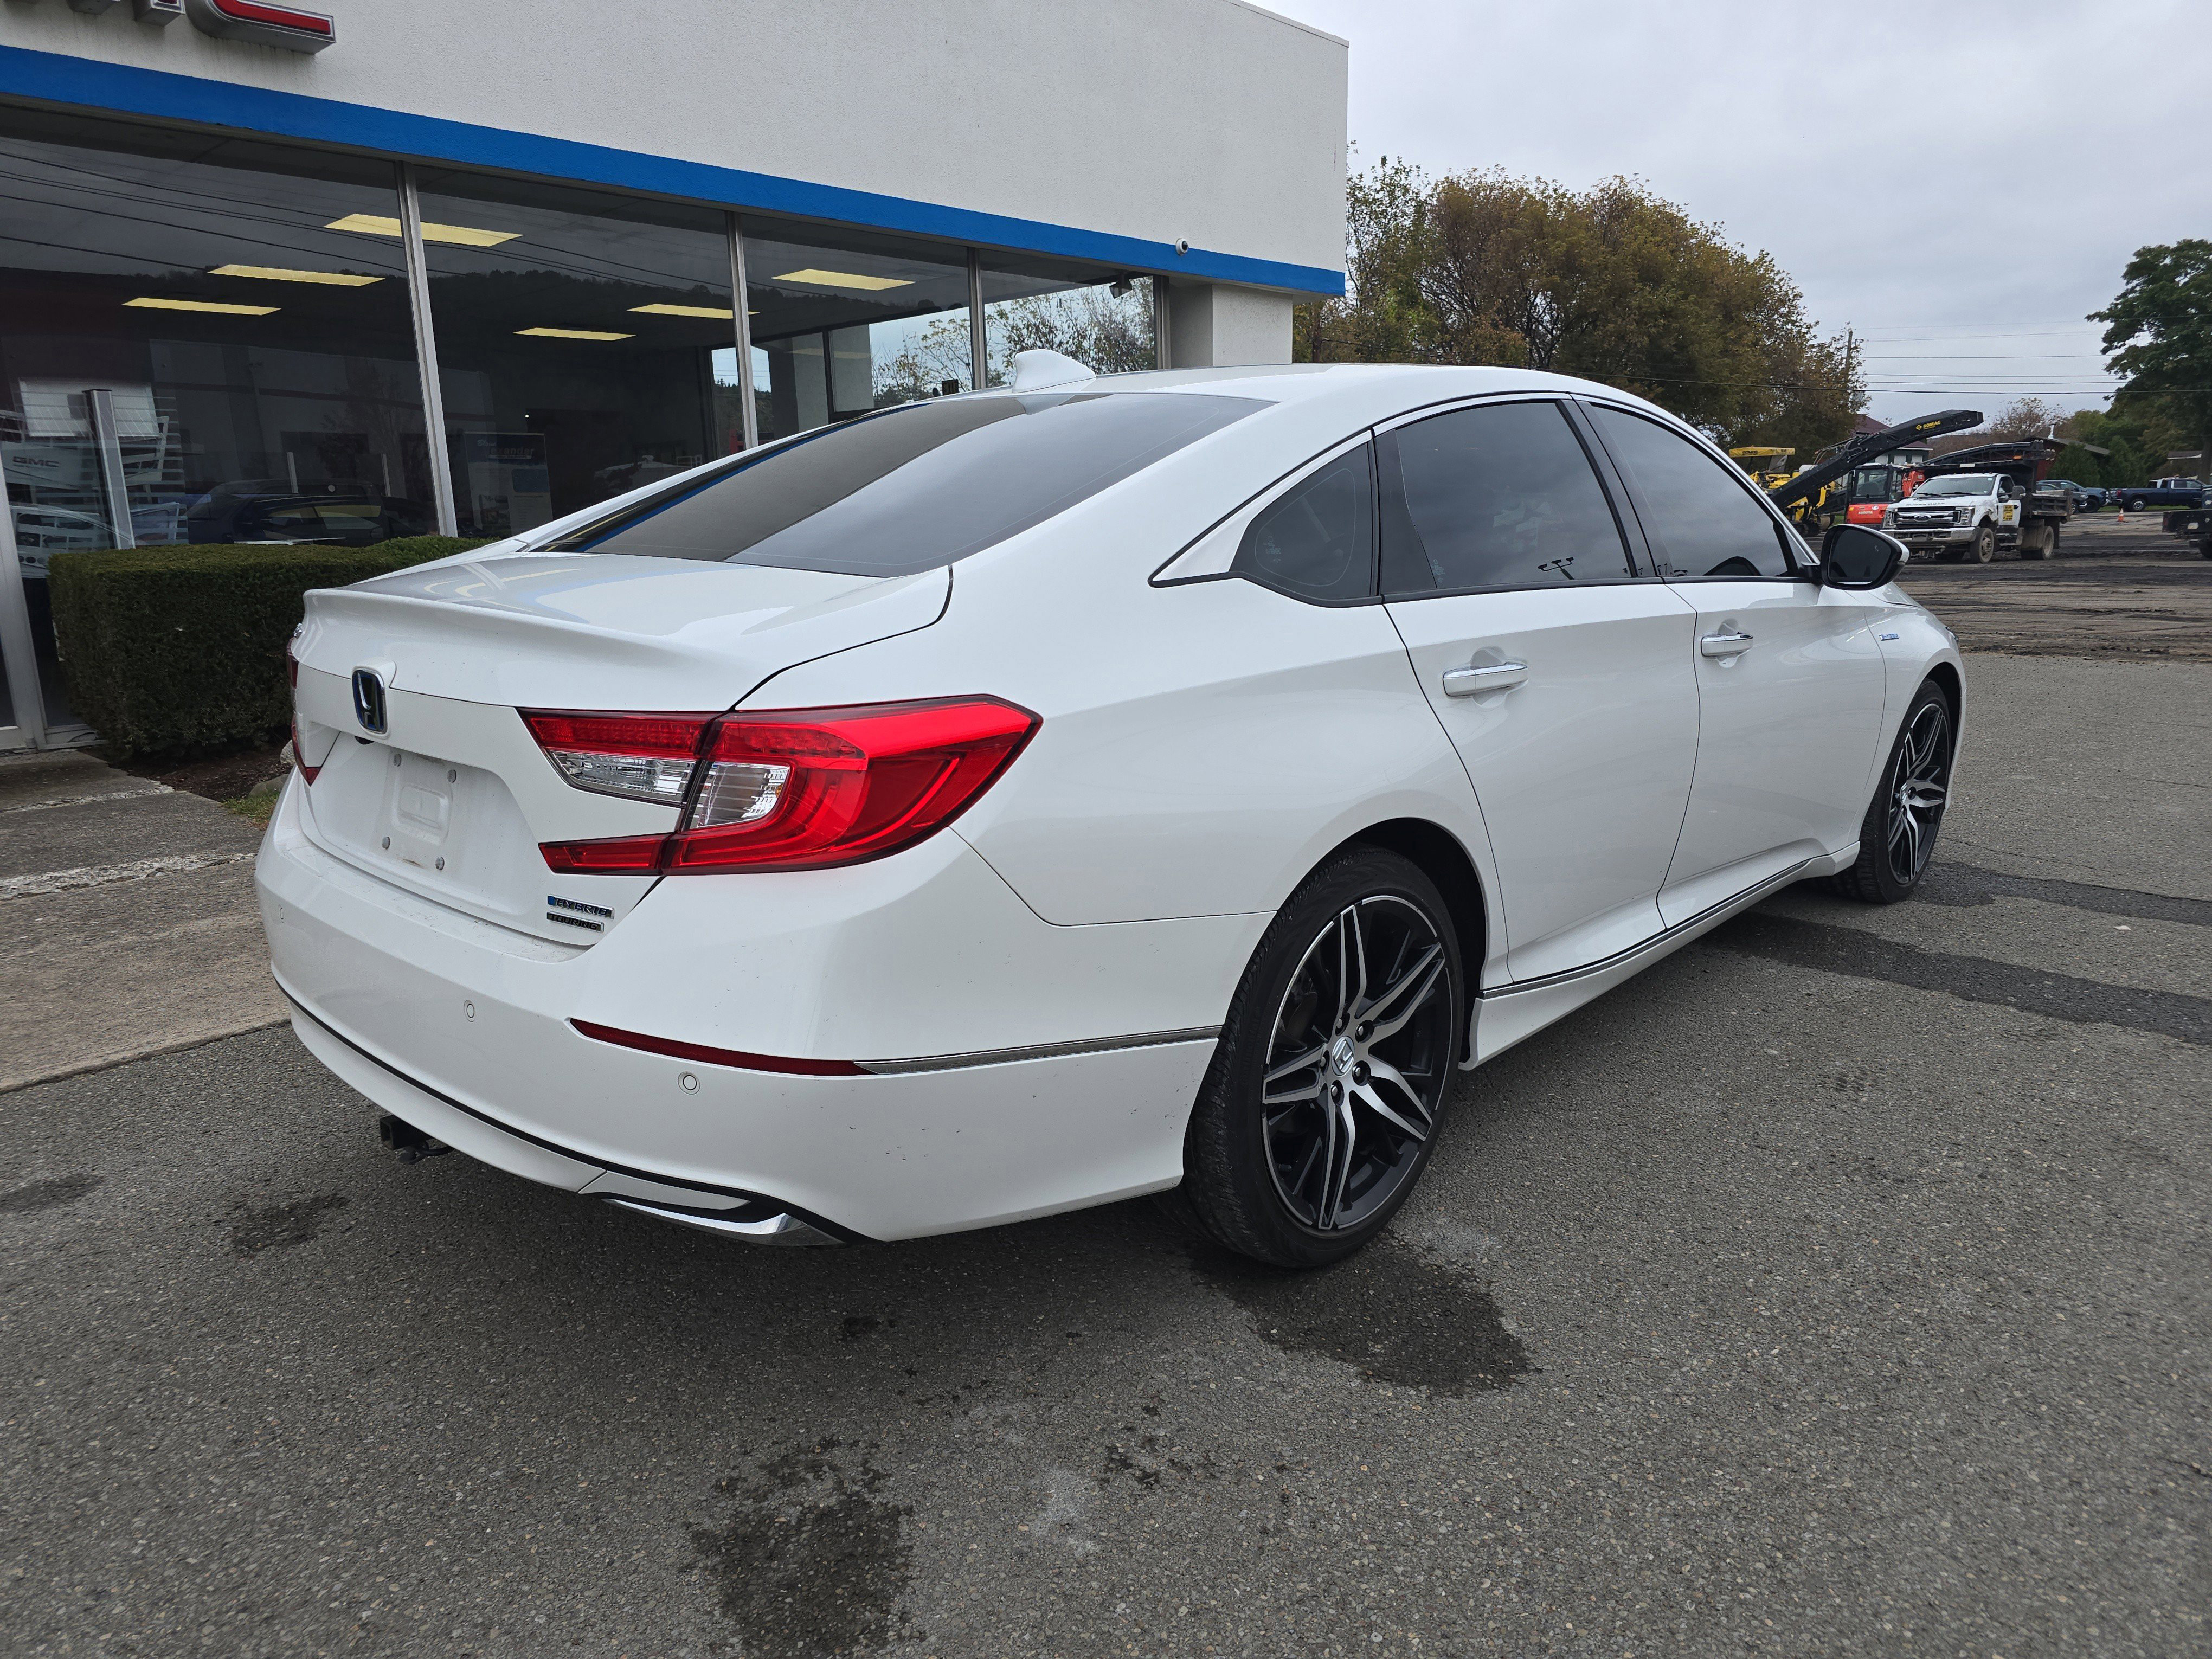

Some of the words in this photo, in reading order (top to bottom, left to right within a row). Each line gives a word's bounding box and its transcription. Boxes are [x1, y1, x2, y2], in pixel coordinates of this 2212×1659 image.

[13, 456, 59, 467] GMC
[555, 898, 607, 915] HYBRID
[550, 914, 598, 930] TOURING
